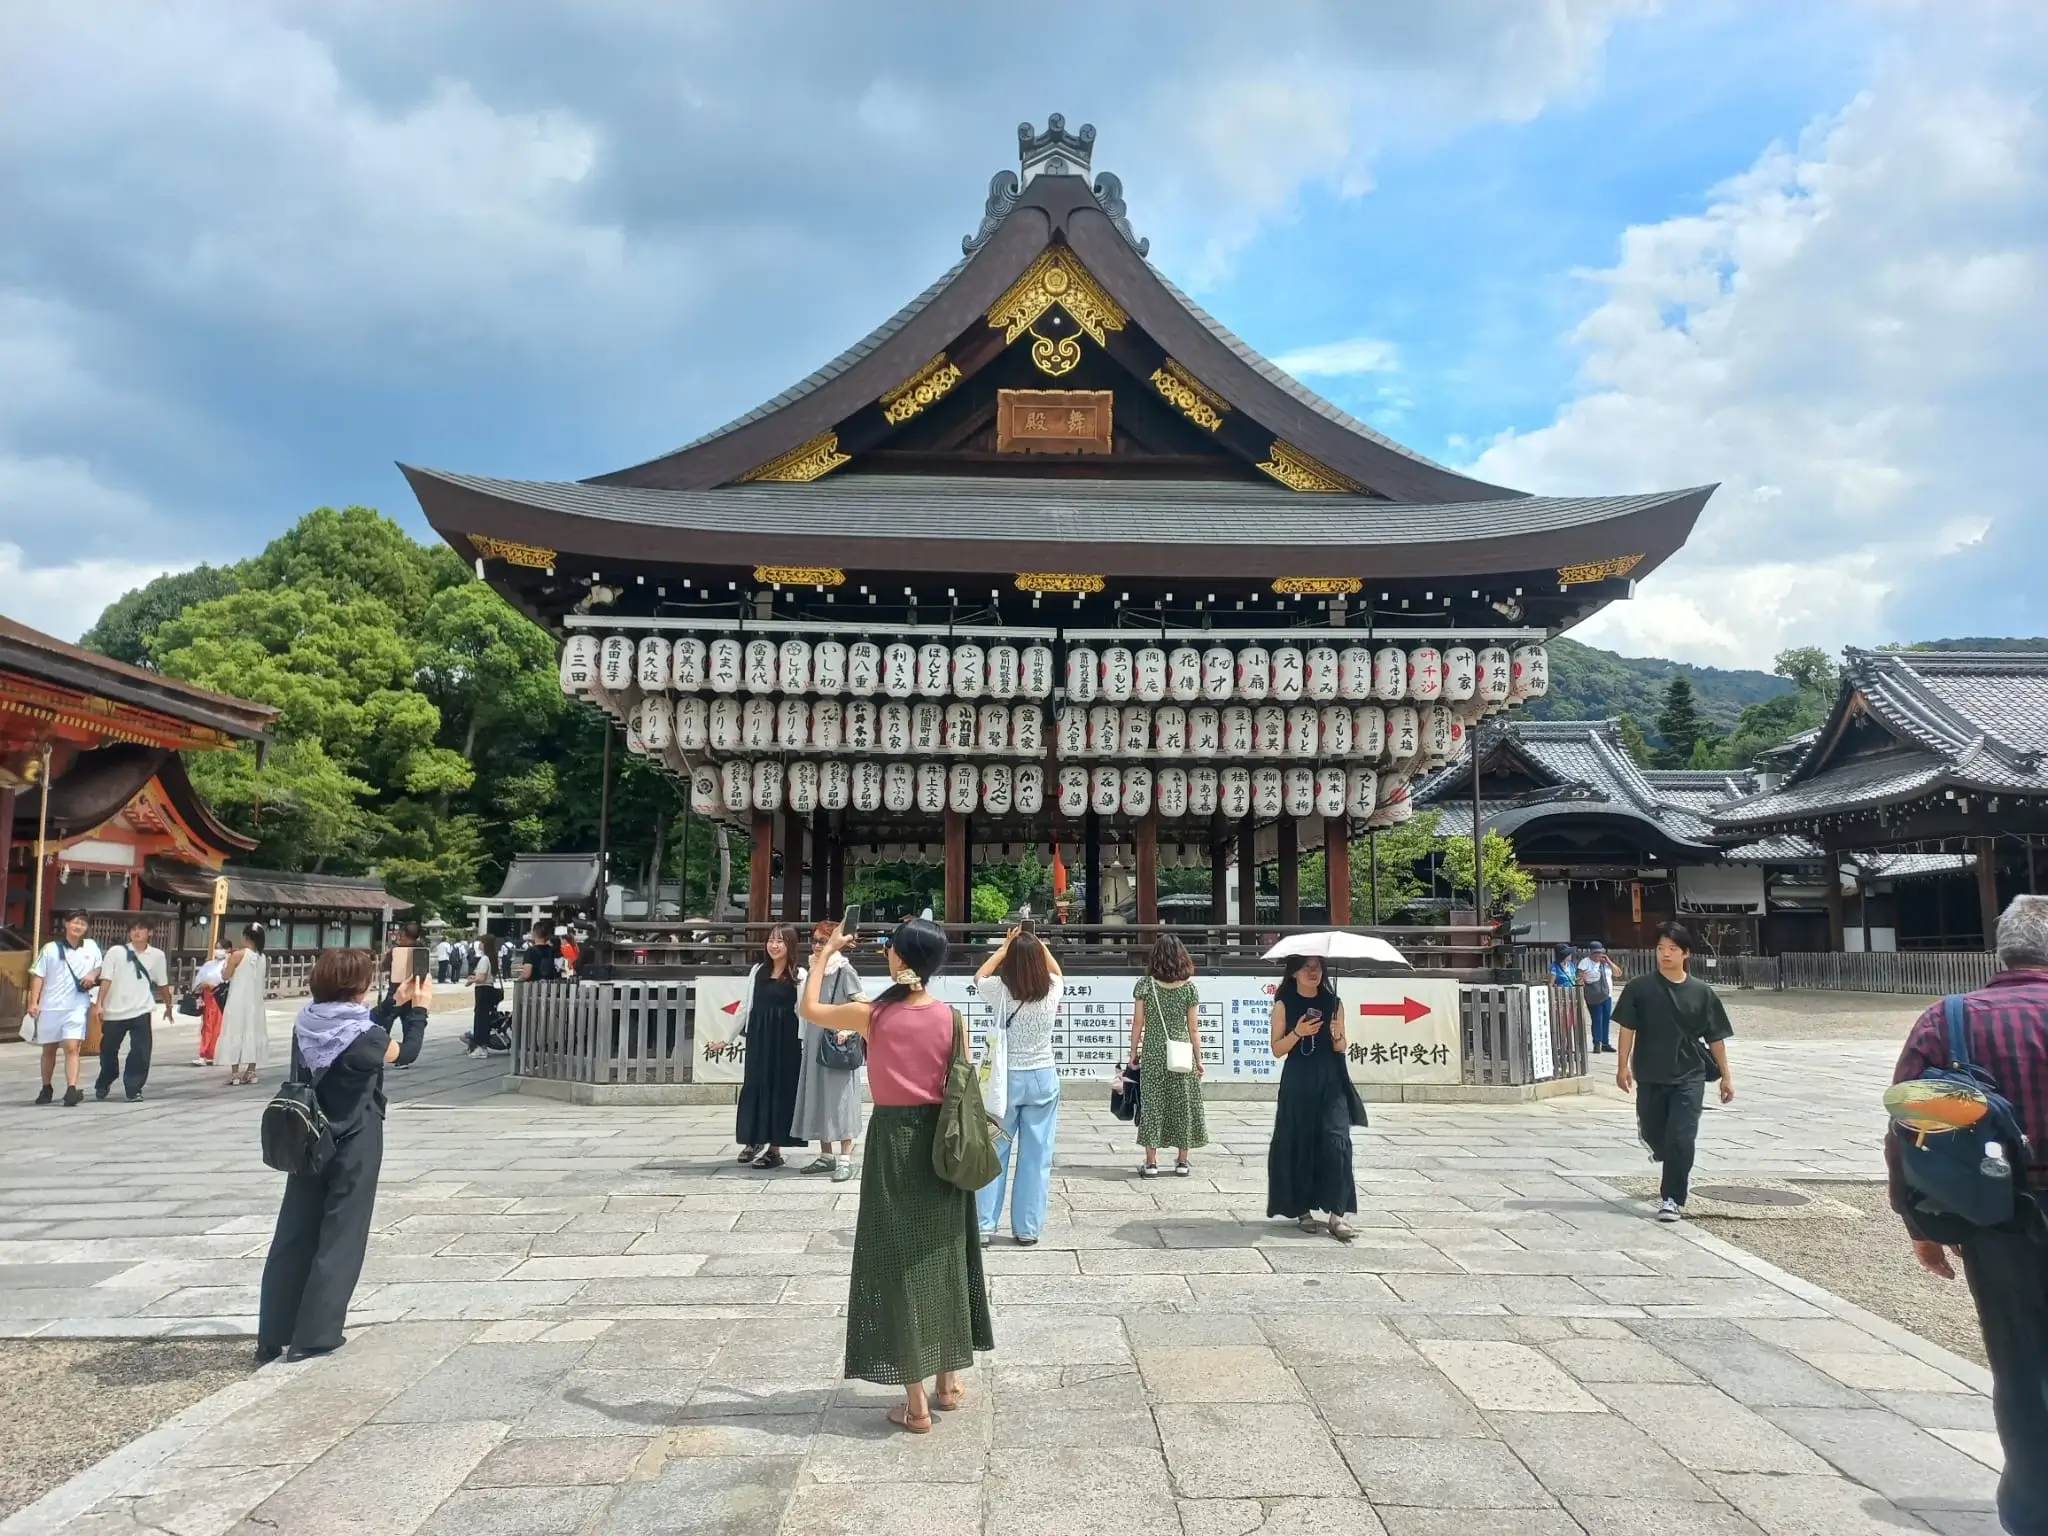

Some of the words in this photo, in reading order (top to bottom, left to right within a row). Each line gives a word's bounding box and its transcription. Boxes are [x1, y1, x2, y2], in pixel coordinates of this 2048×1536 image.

[716, 643, 733, 683] たまや
[751, 643, 768, 685] 富美代
[961, 648, 977, 691] ふく葉
[1114, 650, 1128, 693] まつもと
[1284, 653, 1299, 692] えん
[1318, 650, 1333, 693] 杉きみ
[1491, 651, 1507, 693] 権兵衛
[1528, 646, 1545, 690] 権兵衛
[1300, 709, 1312, 751] ちもと
[1335, 709, 1346, 750] ちもと
[1357, 773, 1370, 811] カトレヤ
[1073, 1019, 1117, 1028] 平成20年生
[1077, 1034, 1113, 1044] 平成6年生
[1077, 1051, 1114, 1060] 平成2年生
[1347, 1042, 1450, 1066] 御朱印受付
